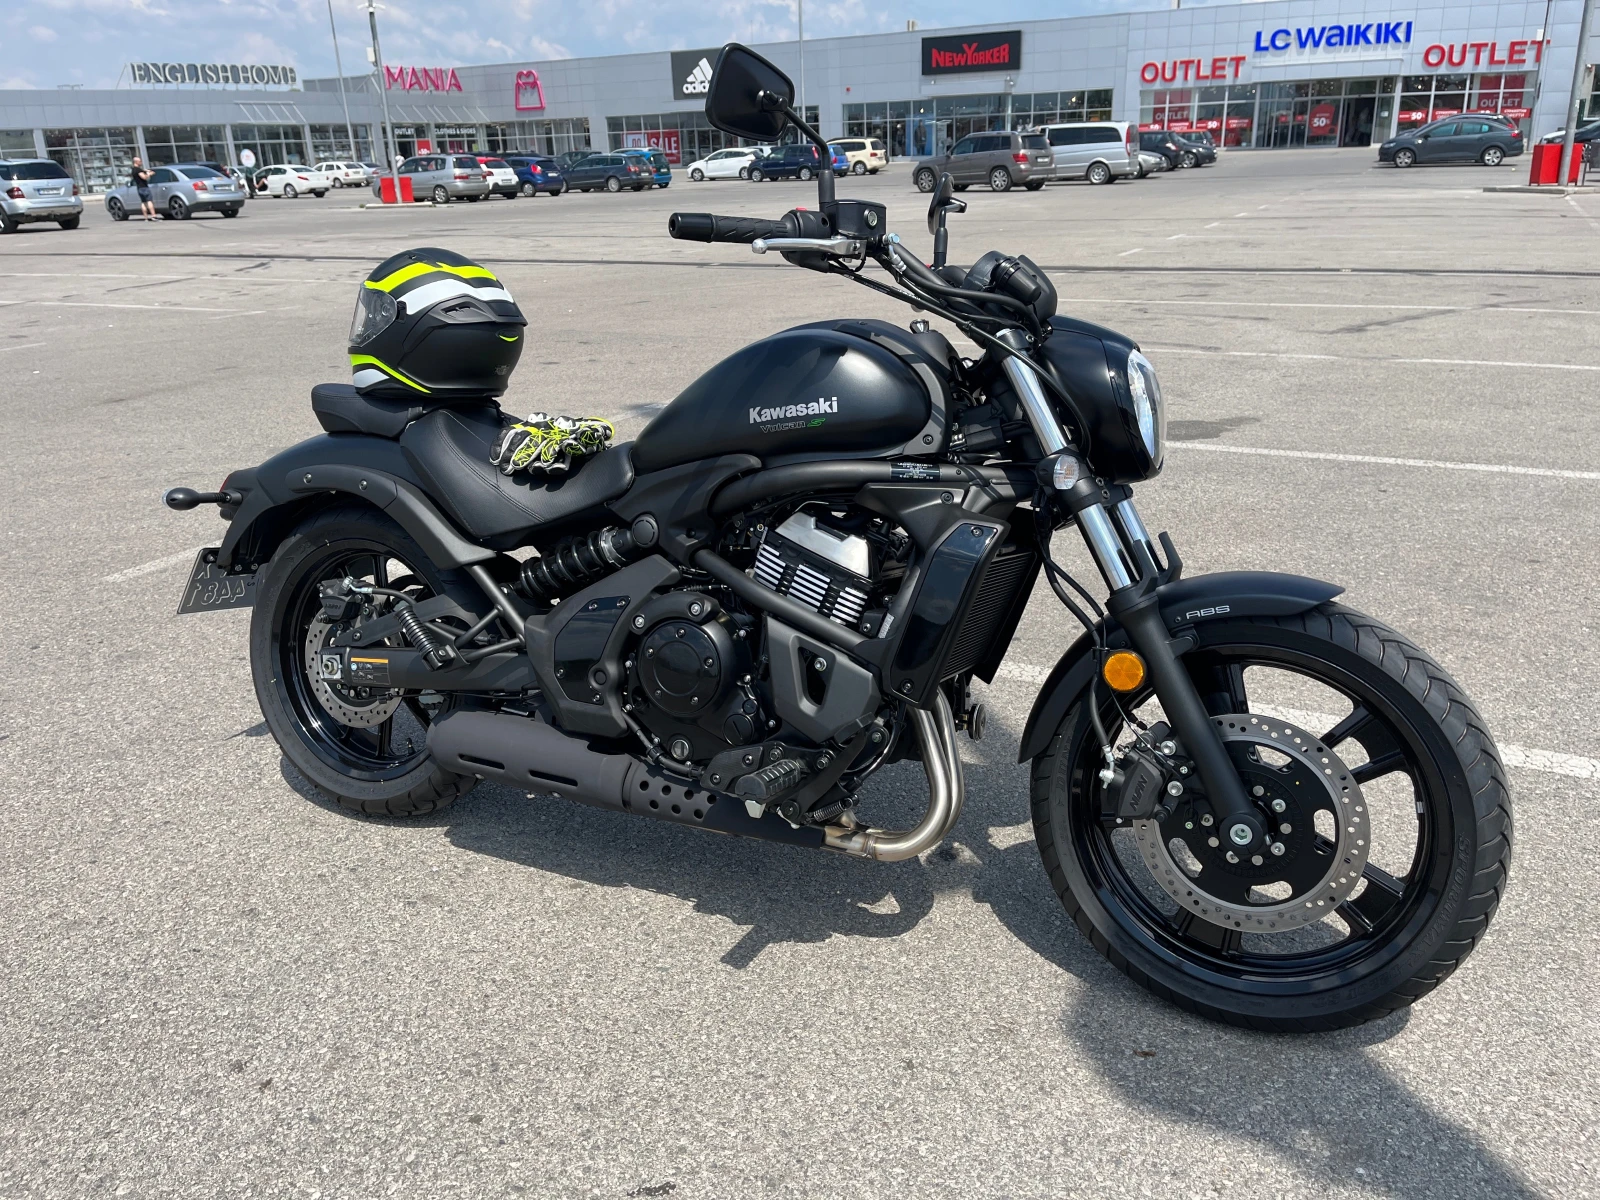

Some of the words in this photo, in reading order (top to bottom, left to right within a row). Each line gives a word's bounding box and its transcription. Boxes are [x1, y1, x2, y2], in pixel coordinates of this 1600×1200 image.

[1255, 29, 1292, 52] LC
[1423, 39, 1551, 68] OUTLET
[131, 62, 230, 84] ENGLISH
[238, 64, 297, 85] HOME
[384, 65, 463, 92] MANIA
[1140, 55, 1247, 84] OUTLET
[683, 80, 709, 94] adid
[394, 127, 415, 135] OUTLET
[650, 136, 678, 154] SALE
[749, 396, 838, 424] Kawasaki
[760, 419, 806, 434] Vulcan
[806, 417, 826, 428] S
[1185, 605, 1231, 620] ABS
